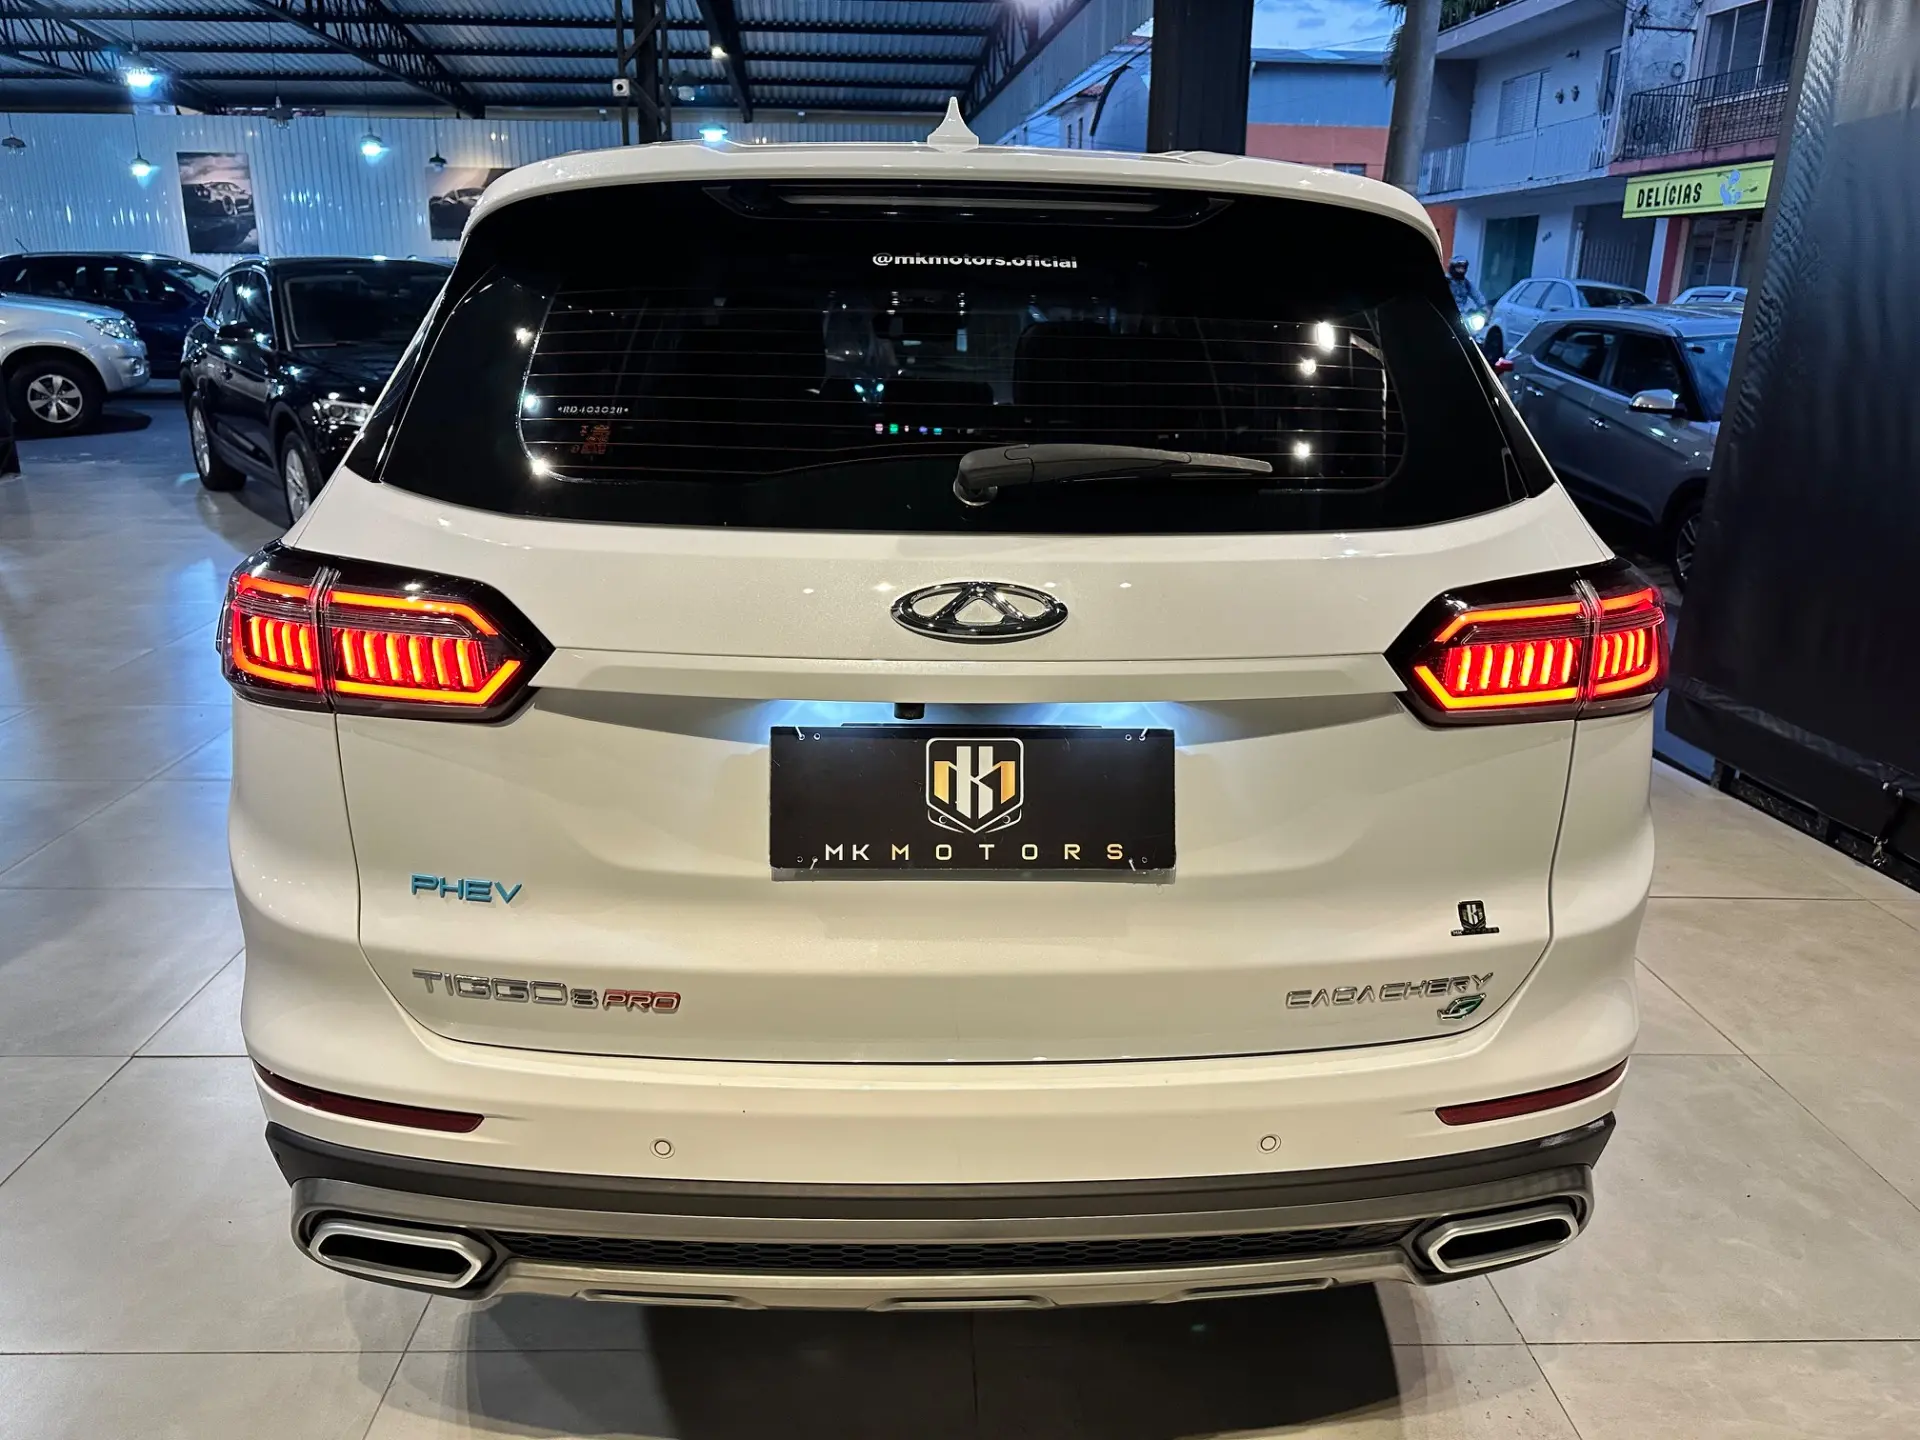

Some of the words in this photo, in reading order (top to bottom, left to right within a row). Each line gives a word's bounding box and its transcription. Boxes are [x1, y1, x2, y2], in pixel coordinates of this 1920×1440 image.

[1636, 182, 1702, 208] DELÍCIAS
[872, 252, 1078, 269] @mkmotors.oficial
[825, 843, 870, 861] MK
[891, 844, 1123, 860] MOTORS
[411, 873, 522, 904] PHEV
